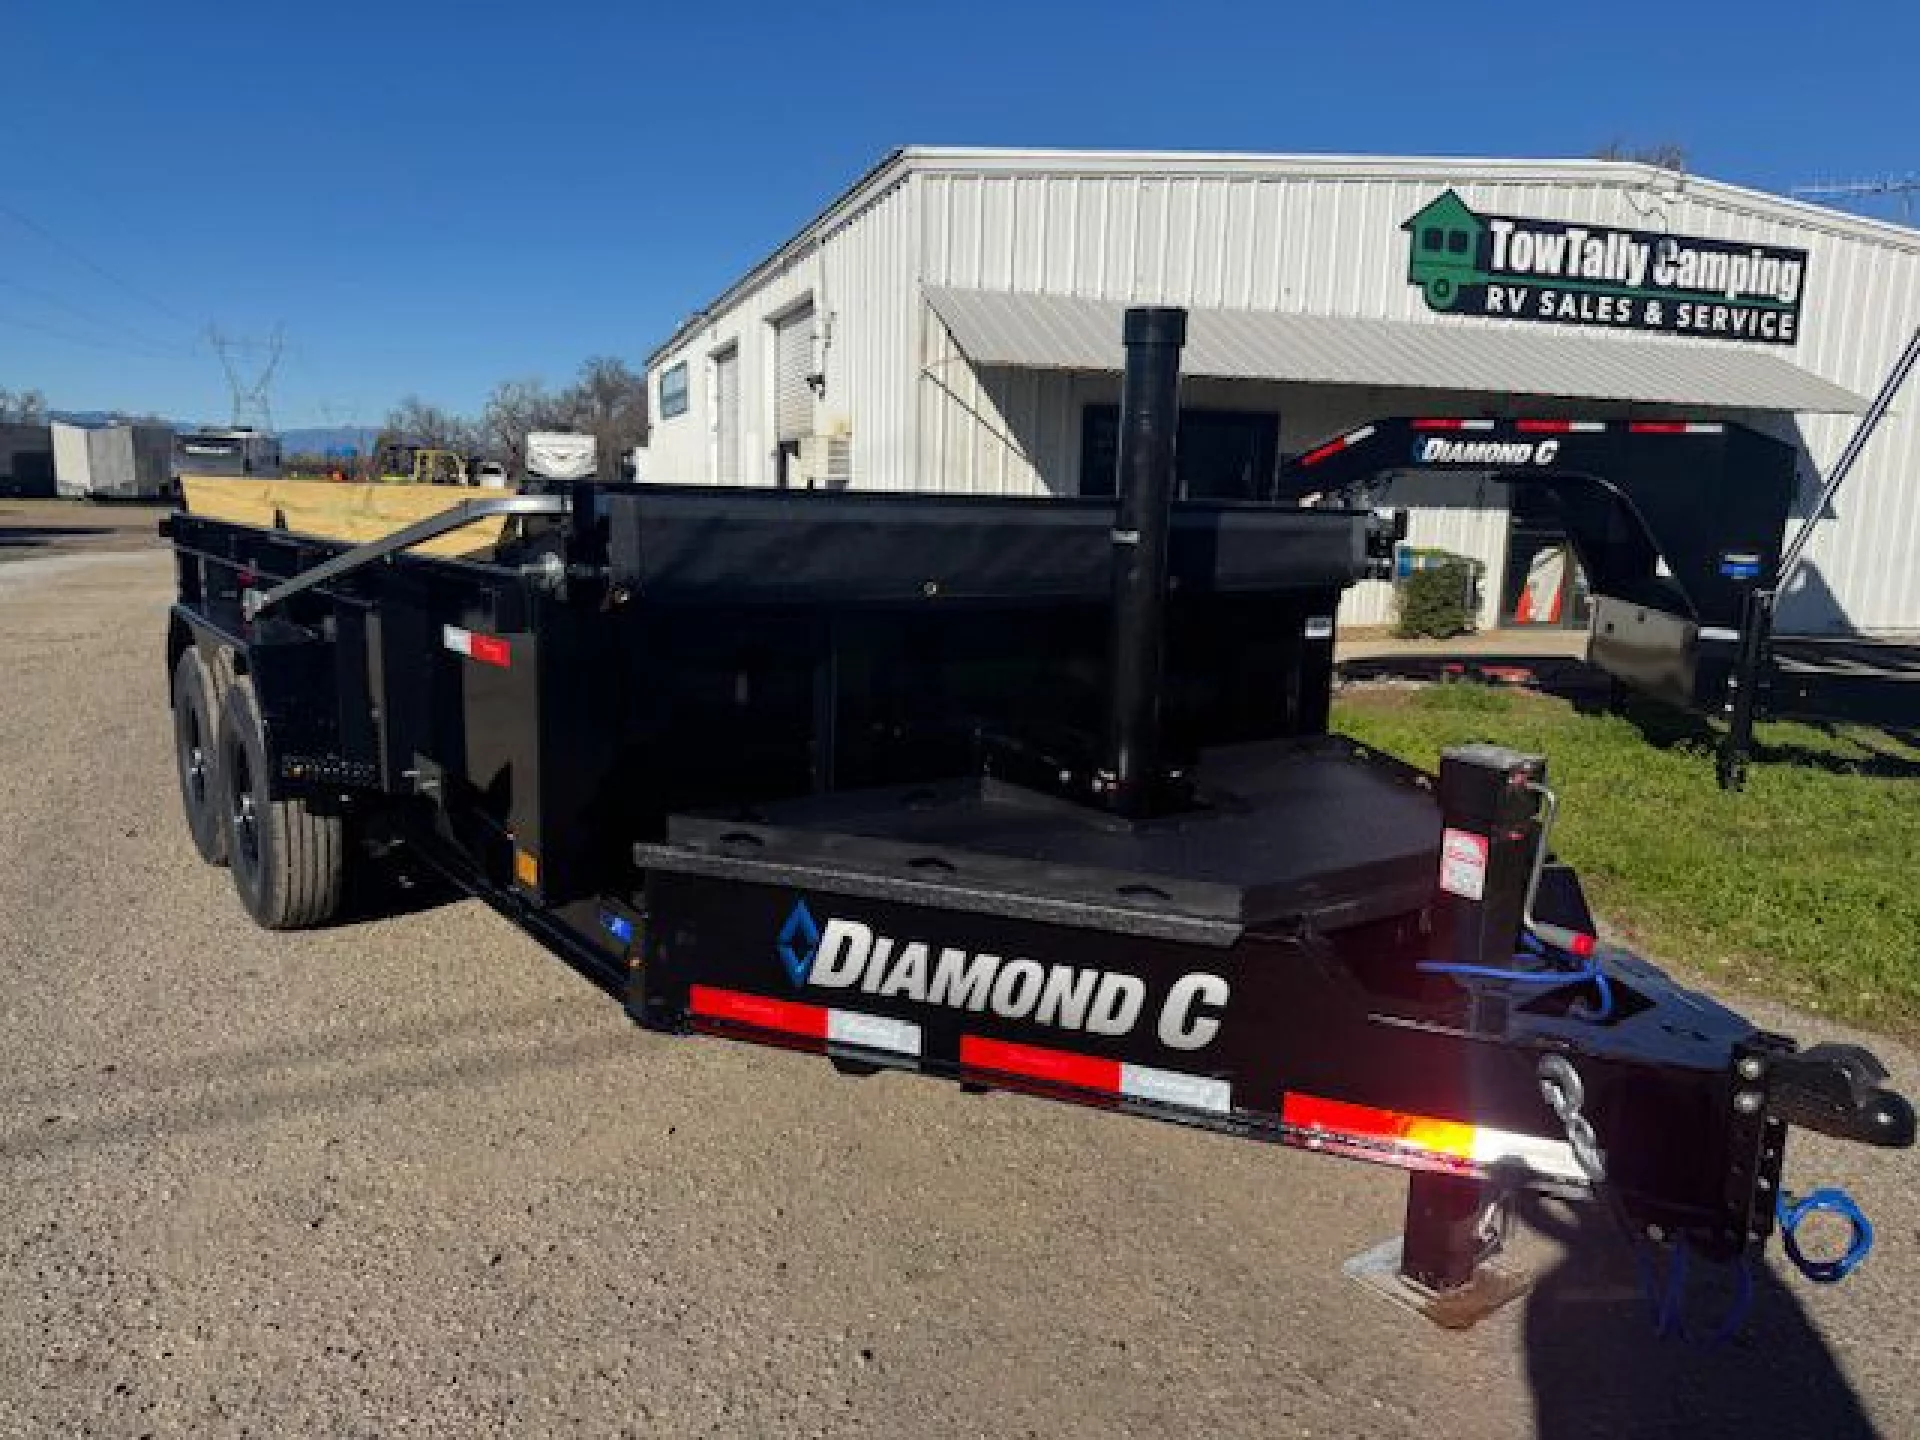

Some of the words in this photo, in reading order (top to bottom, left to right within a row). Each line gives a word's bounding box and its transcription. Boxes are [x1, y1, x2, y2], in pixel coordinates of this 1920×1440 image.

[1490, 221, 1649, 286] TowTally
[1653, 239, 1801, 303] Camping
[1486, 285, 1528, 312] RV
[1538, 290, 1632, 323] SALES
[1643, 299, 1663, 326] &
[1676, 304, 1796, 338] SERVICE
[1535, 440, 1560, 465] C
[808, 917, 1147, 1036] DIAMOND
[1157, 972, 1231, 1050] C
